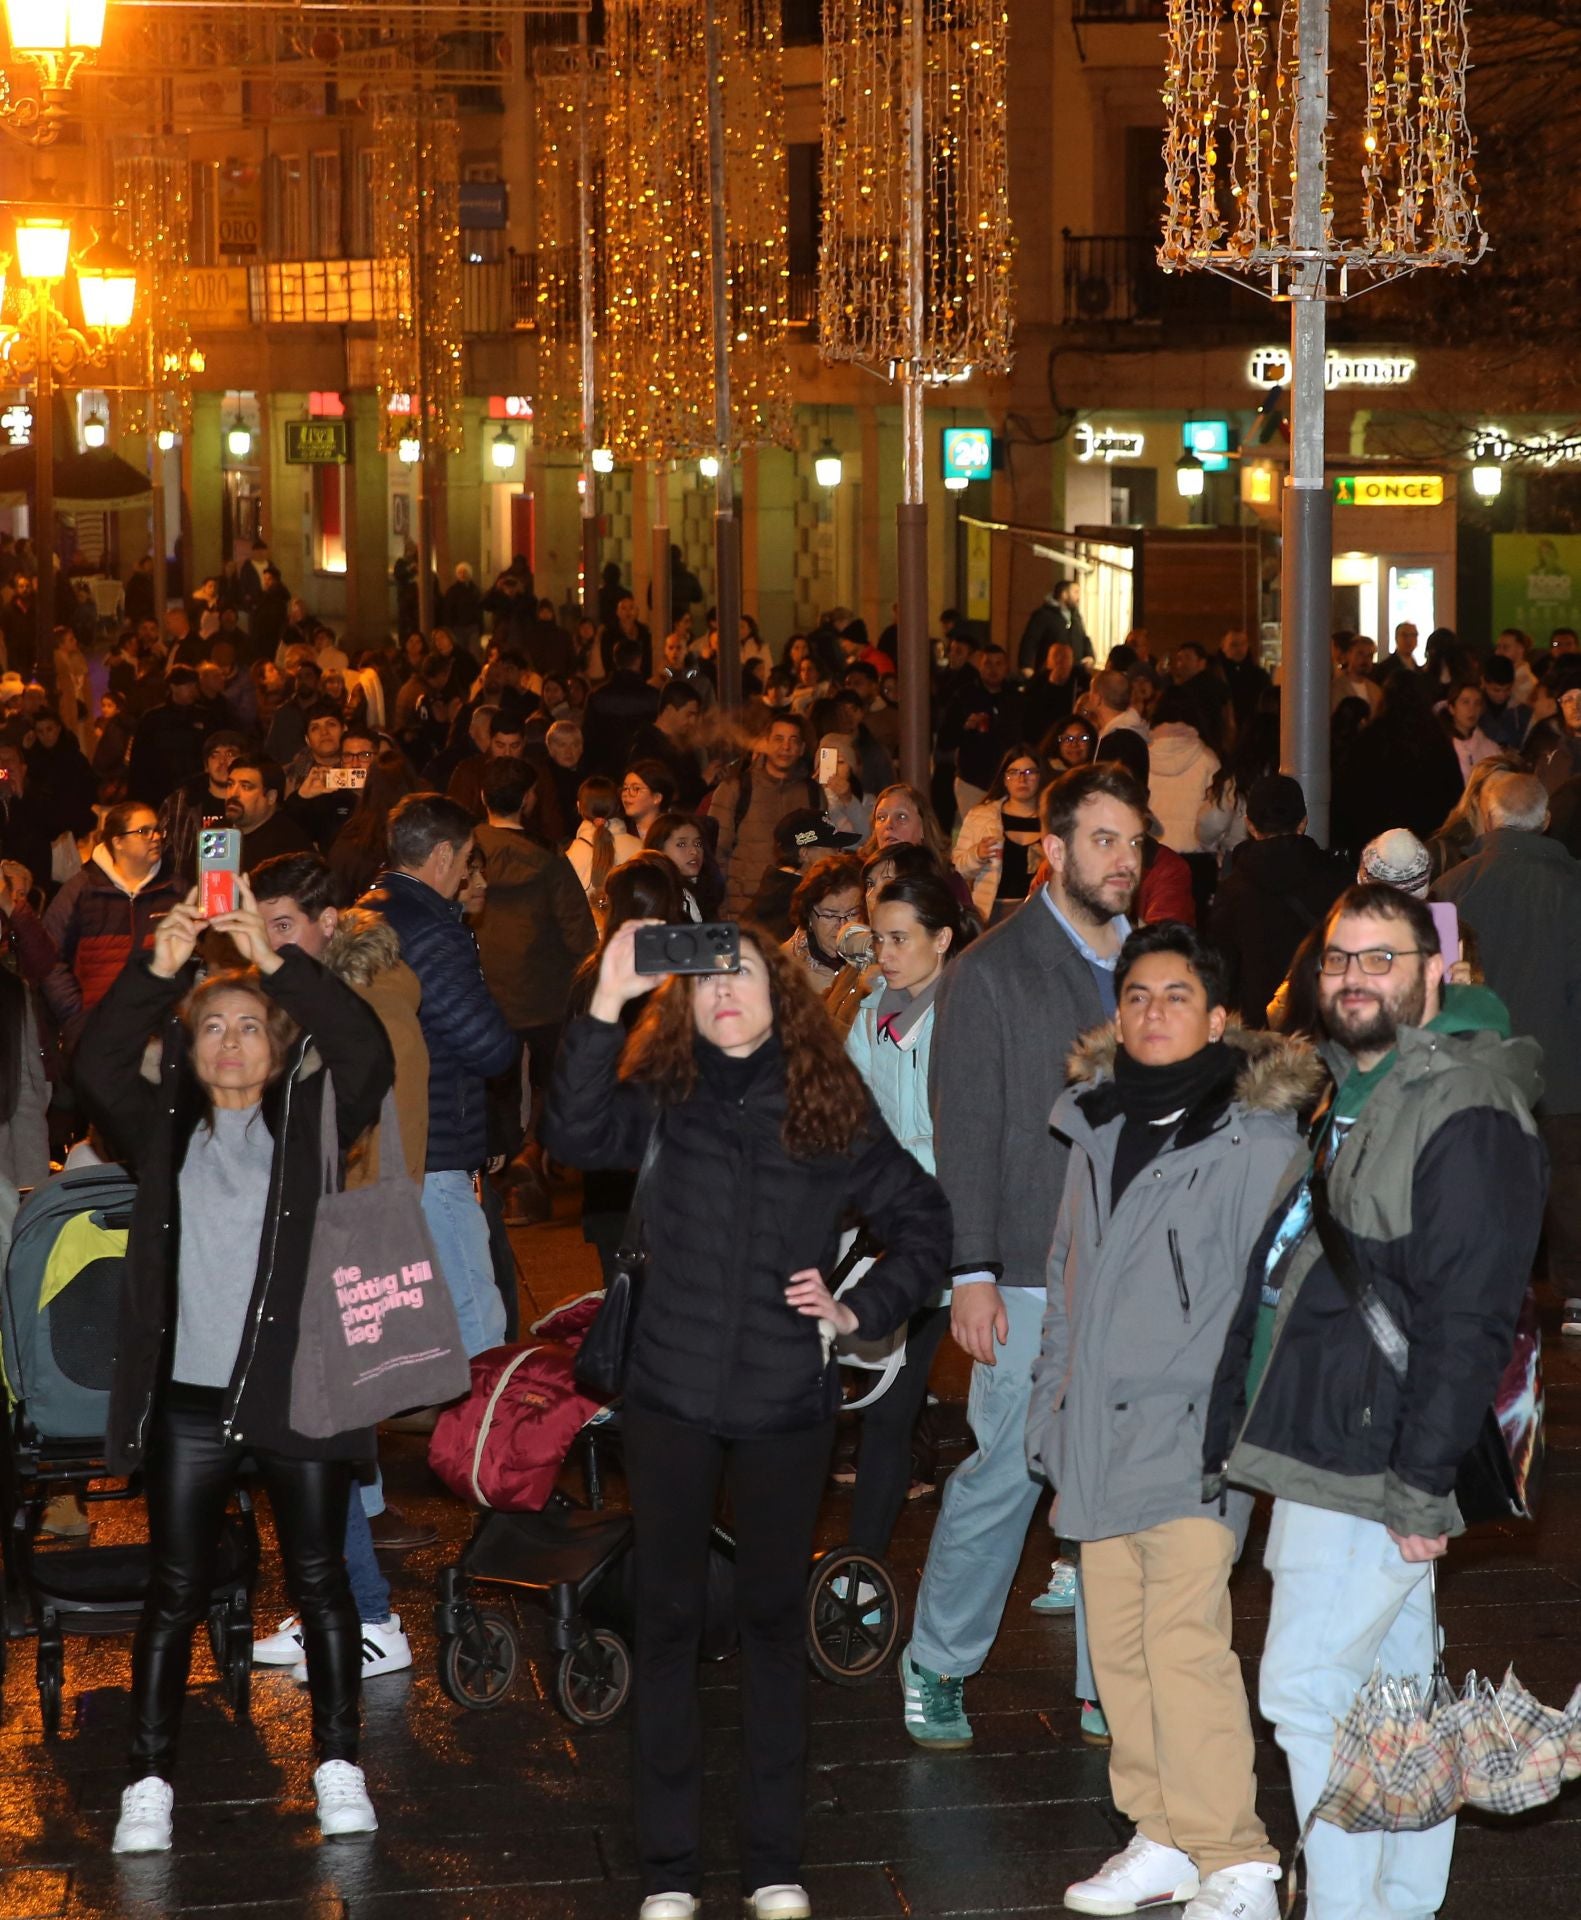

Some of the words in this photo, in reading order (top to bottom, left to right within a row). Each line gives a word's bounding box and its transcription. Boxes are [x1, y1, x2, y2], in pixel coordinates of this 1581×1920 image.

[219, 221, 257, 242] ORO
[1366, 484, 1432, 498] ONCE
[332, 1265, 361, 1287] the
[336, 1274, 399, 1308] Notting
[401, 1260, 433, 1286] Hill
[341, 1287, 424, 1326] shopping
[1232, 1902, 1247, 1919] FILA
